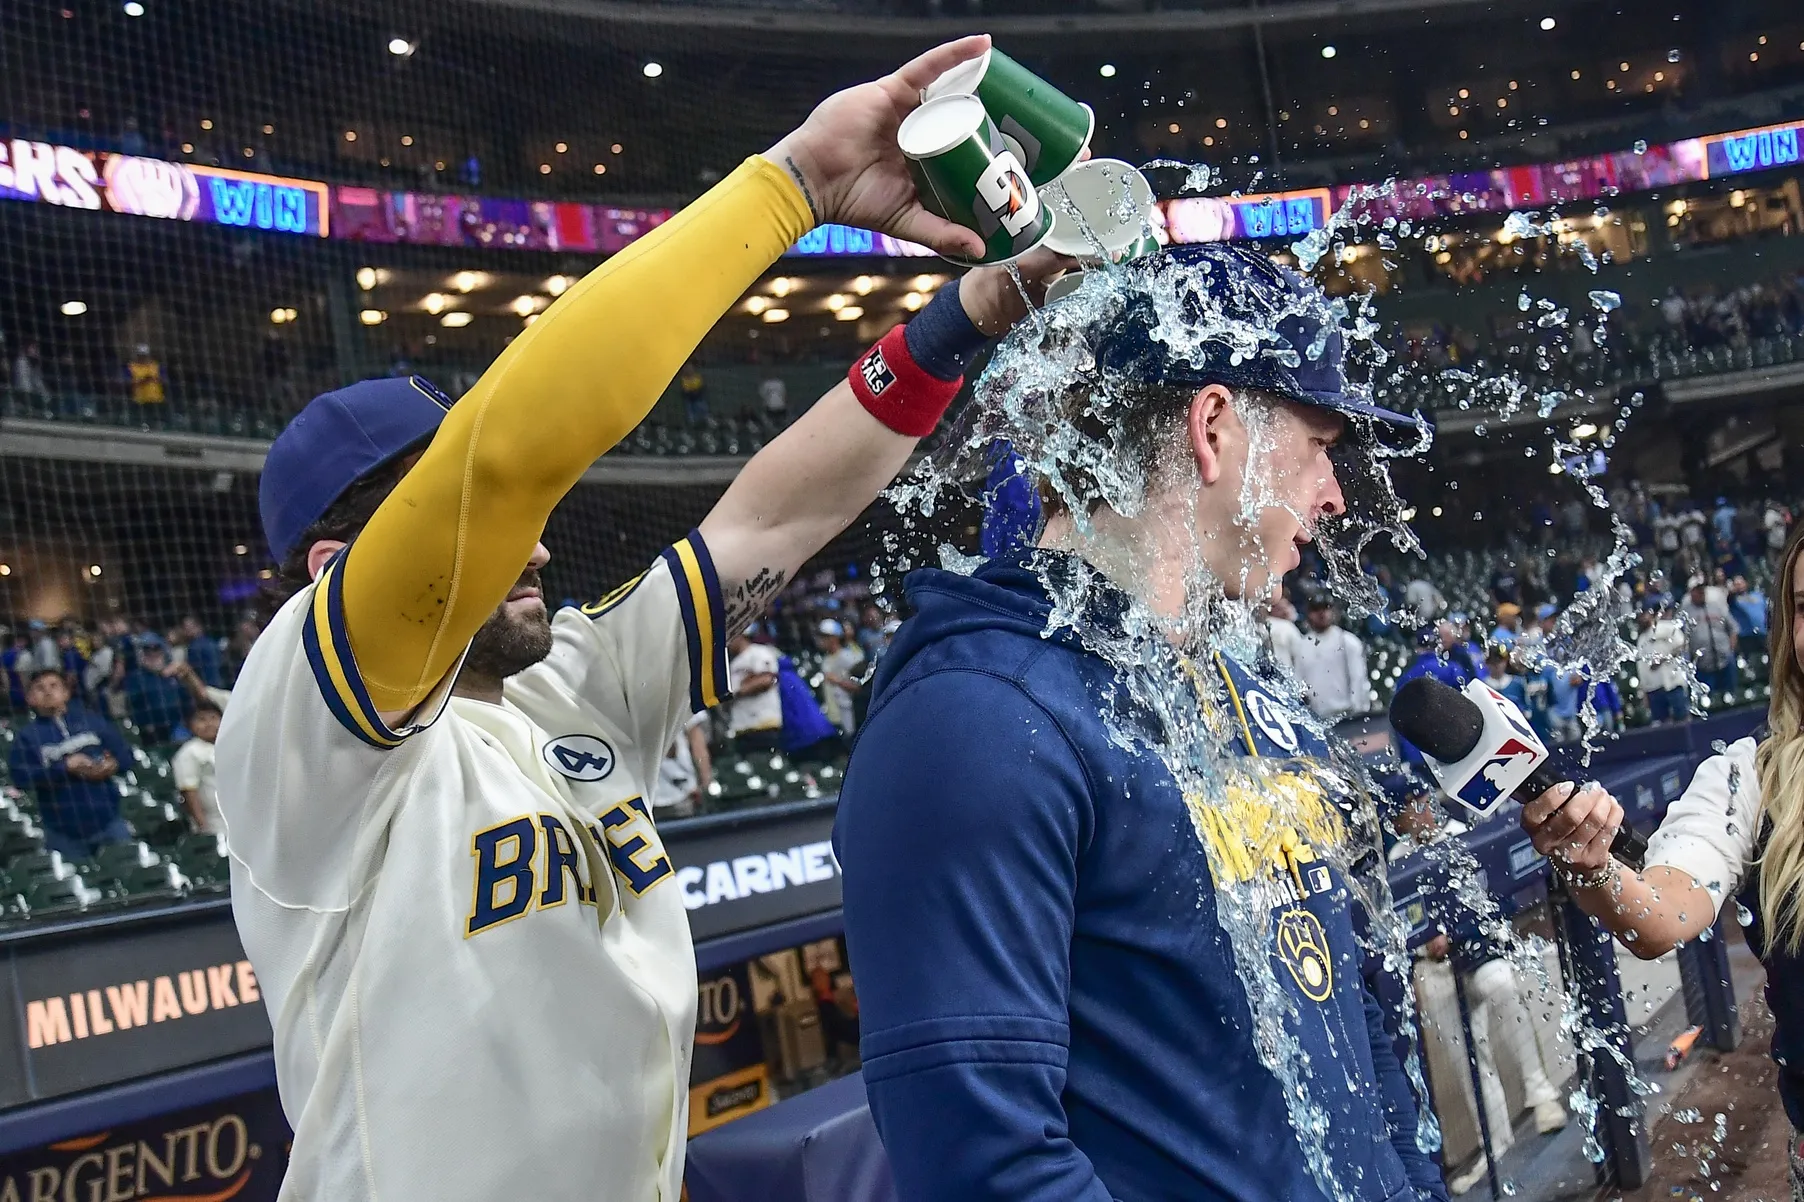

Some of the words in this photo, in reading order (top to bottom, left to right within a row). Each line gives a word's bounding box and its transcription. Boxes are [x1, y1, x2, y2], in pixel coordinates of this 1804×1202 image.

[1723, 128, 1798, 171] WIN
[211, 176, 306, 233] WIN
[1239, 197, 1313, 237] WIN
[1255, 696, 1294, 745] 4
[552, 743, 608, 774] 4
[464, 794, 676, 940] BRE
[675, 840, 842, 910] CARNE
[26, 960, 260, 1048] MILWAUKE
[699, 976, 739, 1025] TO
